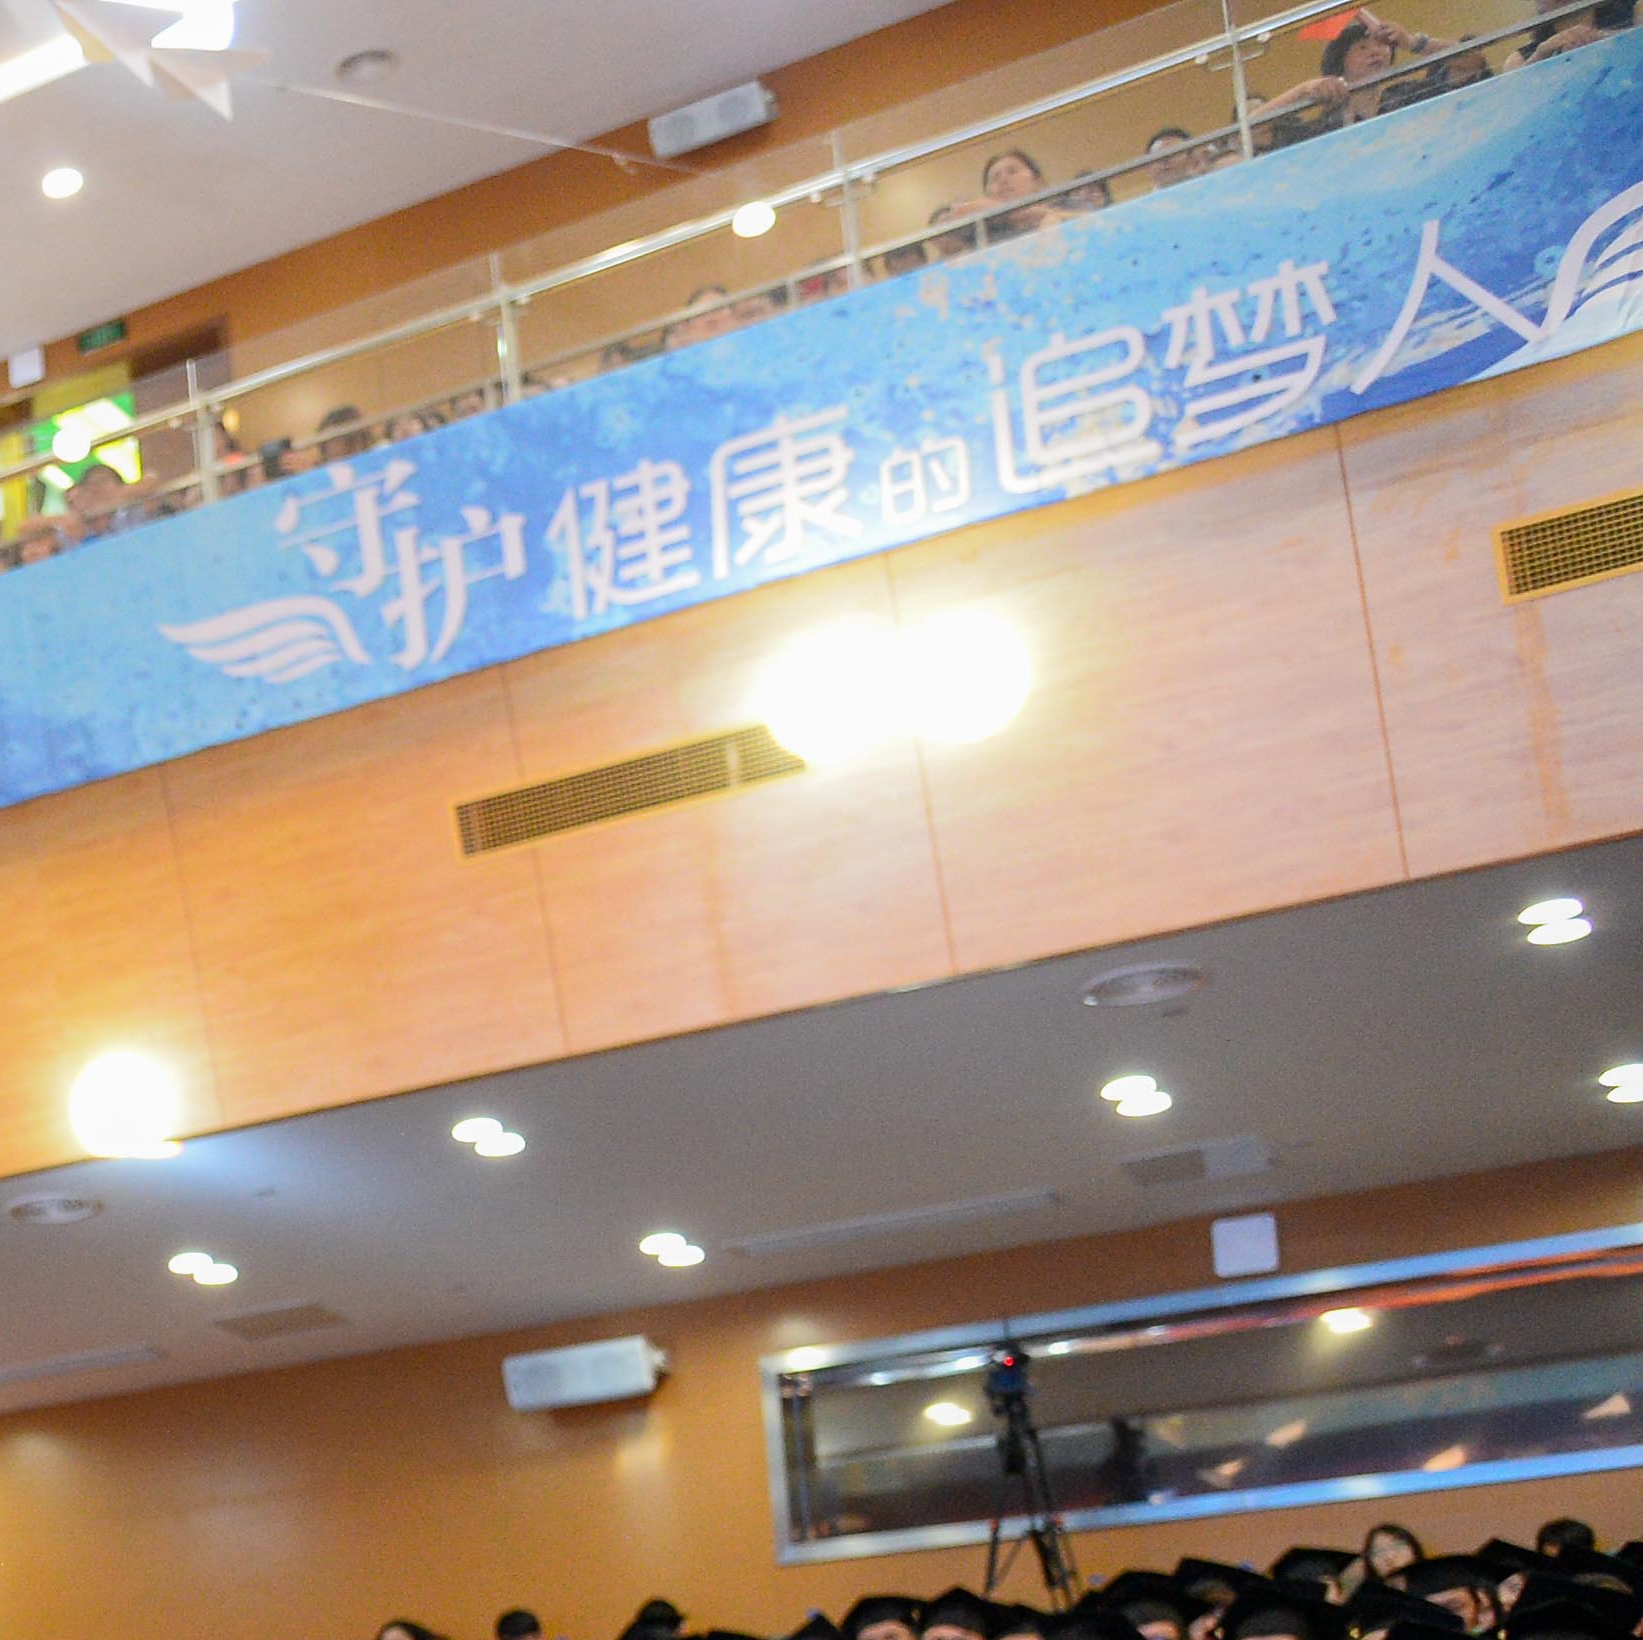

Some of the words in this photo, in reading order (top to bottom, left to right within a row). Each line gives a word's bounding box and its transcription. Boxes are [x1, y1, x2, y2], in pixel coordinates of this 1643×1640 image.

[271, 216, 1551, 672] 守护健康的追梦人
